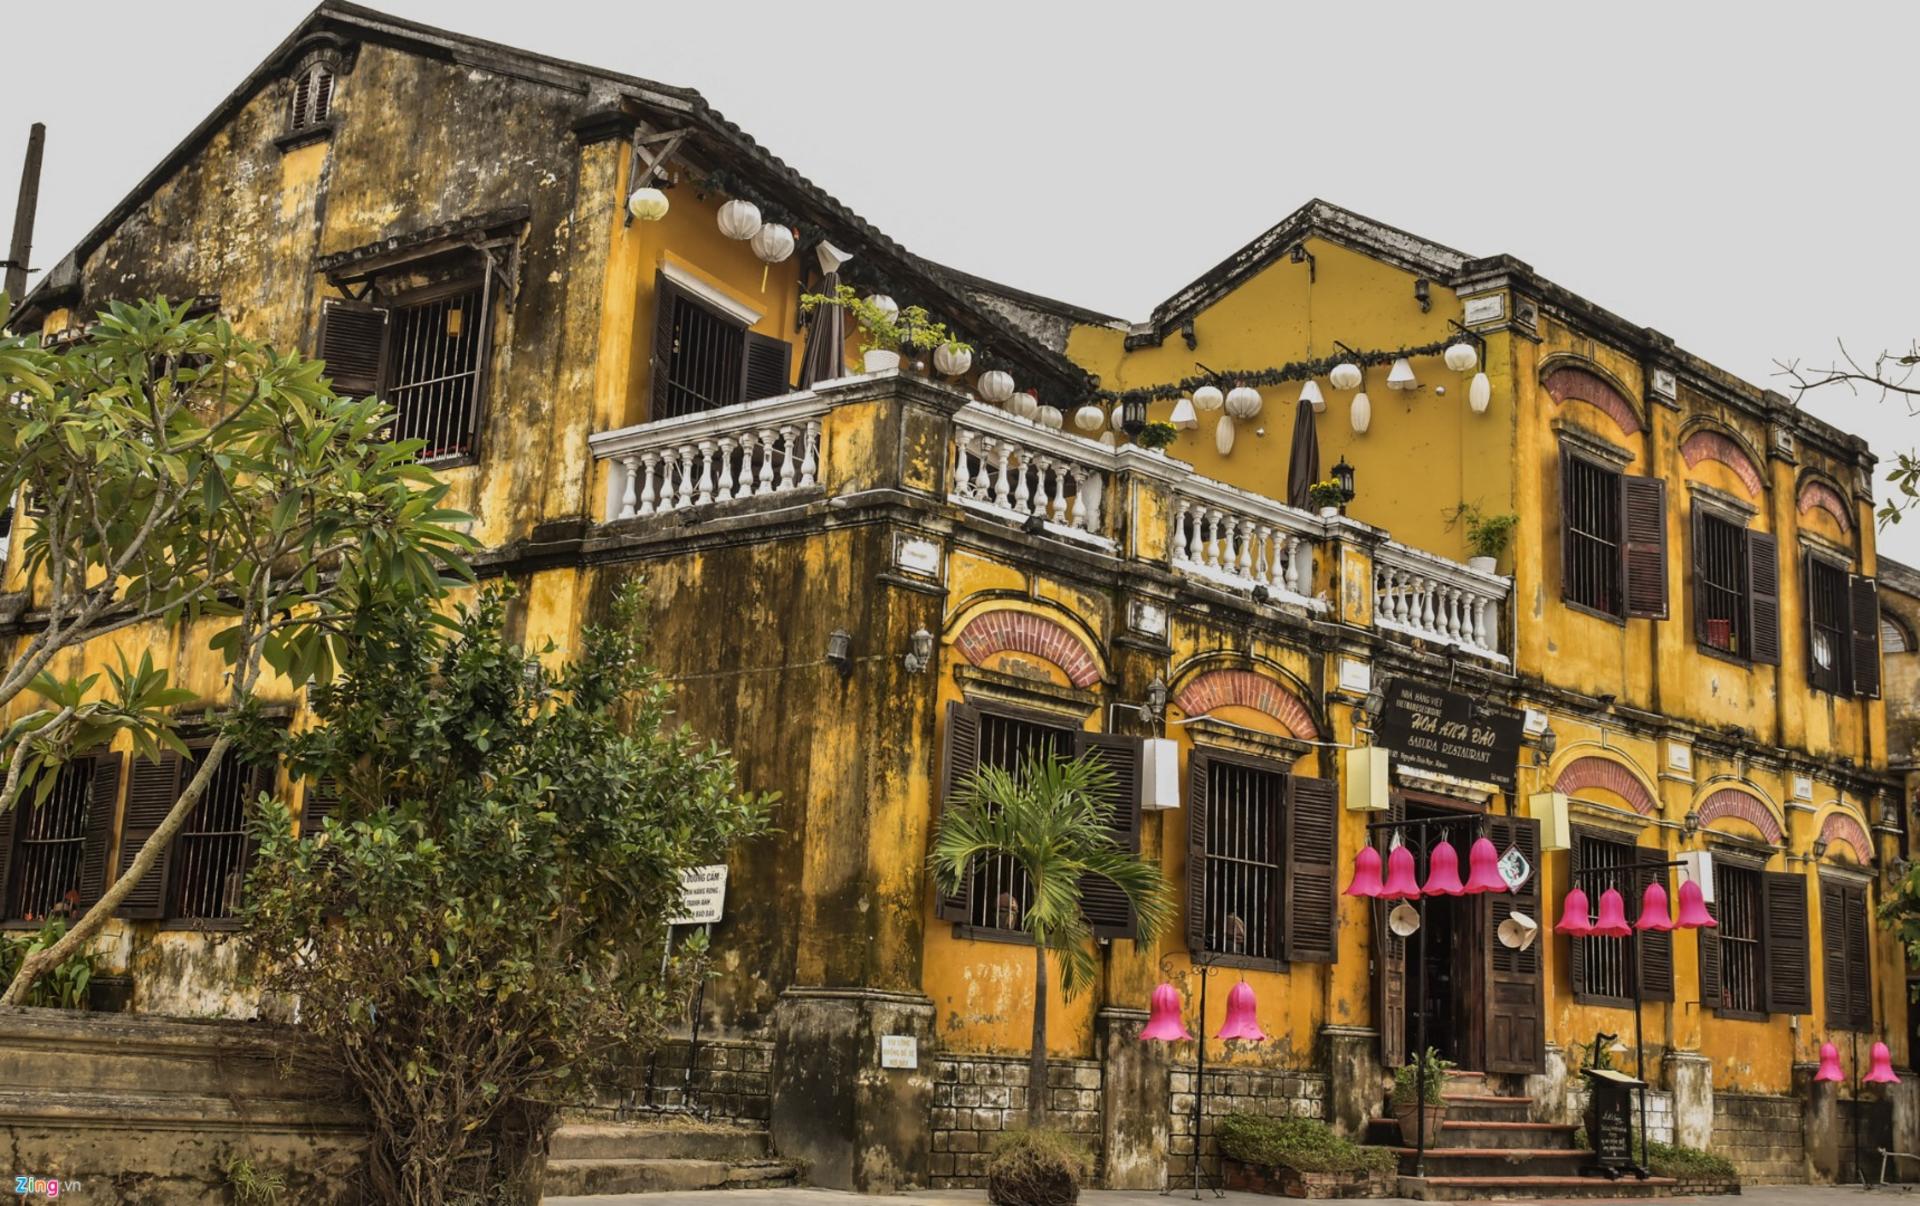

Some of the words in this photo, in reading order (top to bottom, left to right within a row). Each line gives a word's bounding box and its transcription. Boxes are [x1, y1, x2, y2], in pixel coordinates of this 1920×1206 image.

[1411, 713, 1438, 733] HOA
[1439, 721, 1469, 741] ANH
[1408, 735, 1438, 752] SAKURA
[1441, 742, 1491, 764] RESTAURANT
